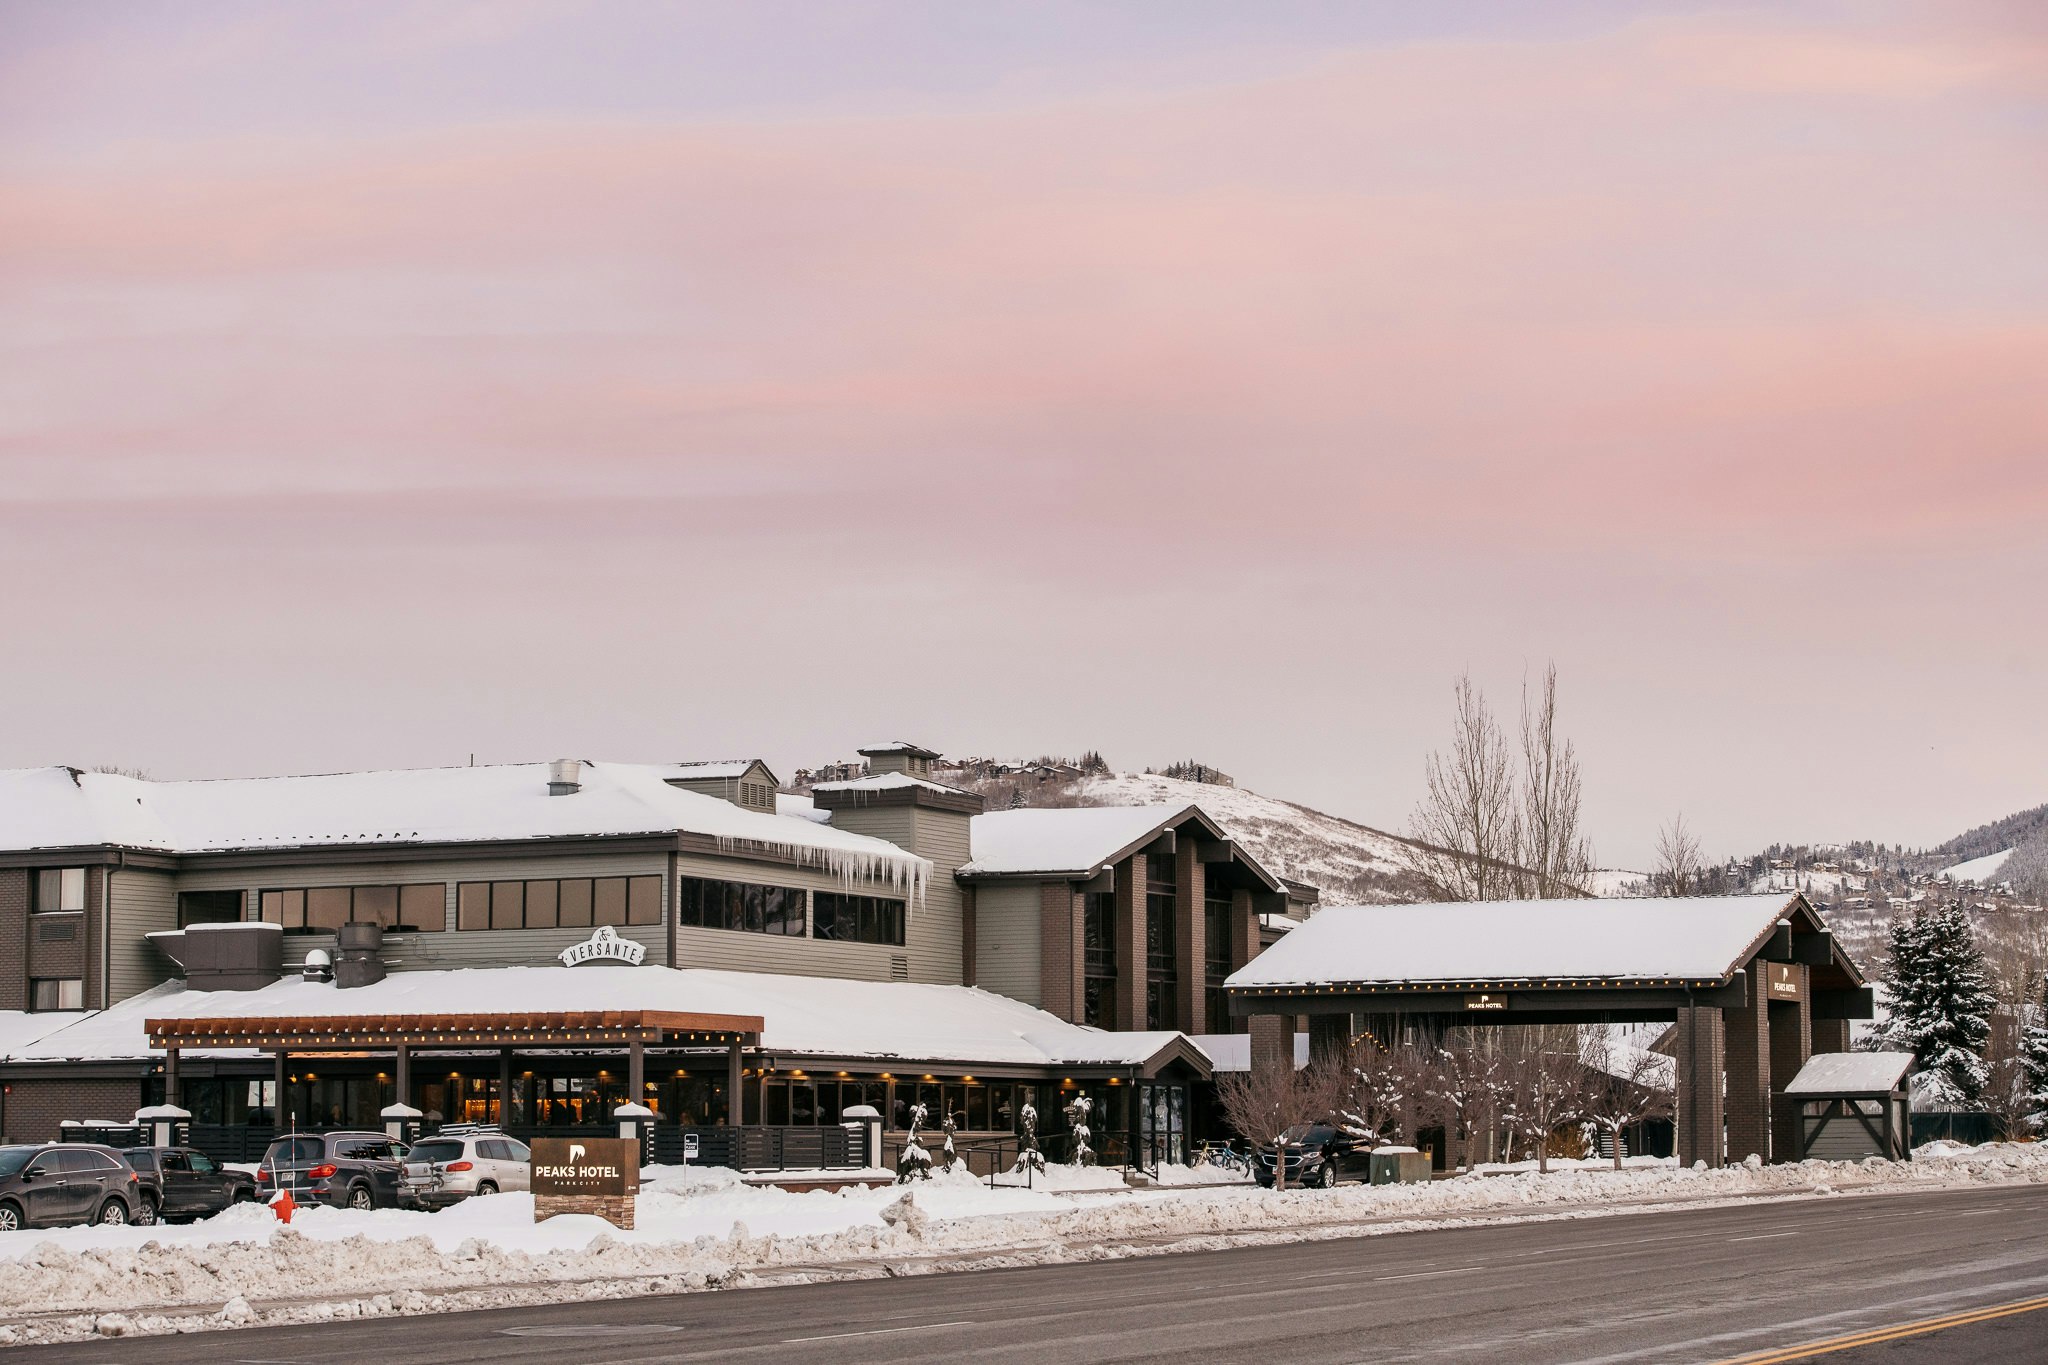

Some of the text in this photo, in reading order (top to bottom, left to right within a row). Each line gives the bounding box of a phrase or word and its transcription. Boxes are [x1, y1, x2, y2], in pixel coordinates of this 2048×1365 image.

[569, 943, 637, 962] VERSANTE
[535, 1166, 620, 1178] PEAKS HOTEL
